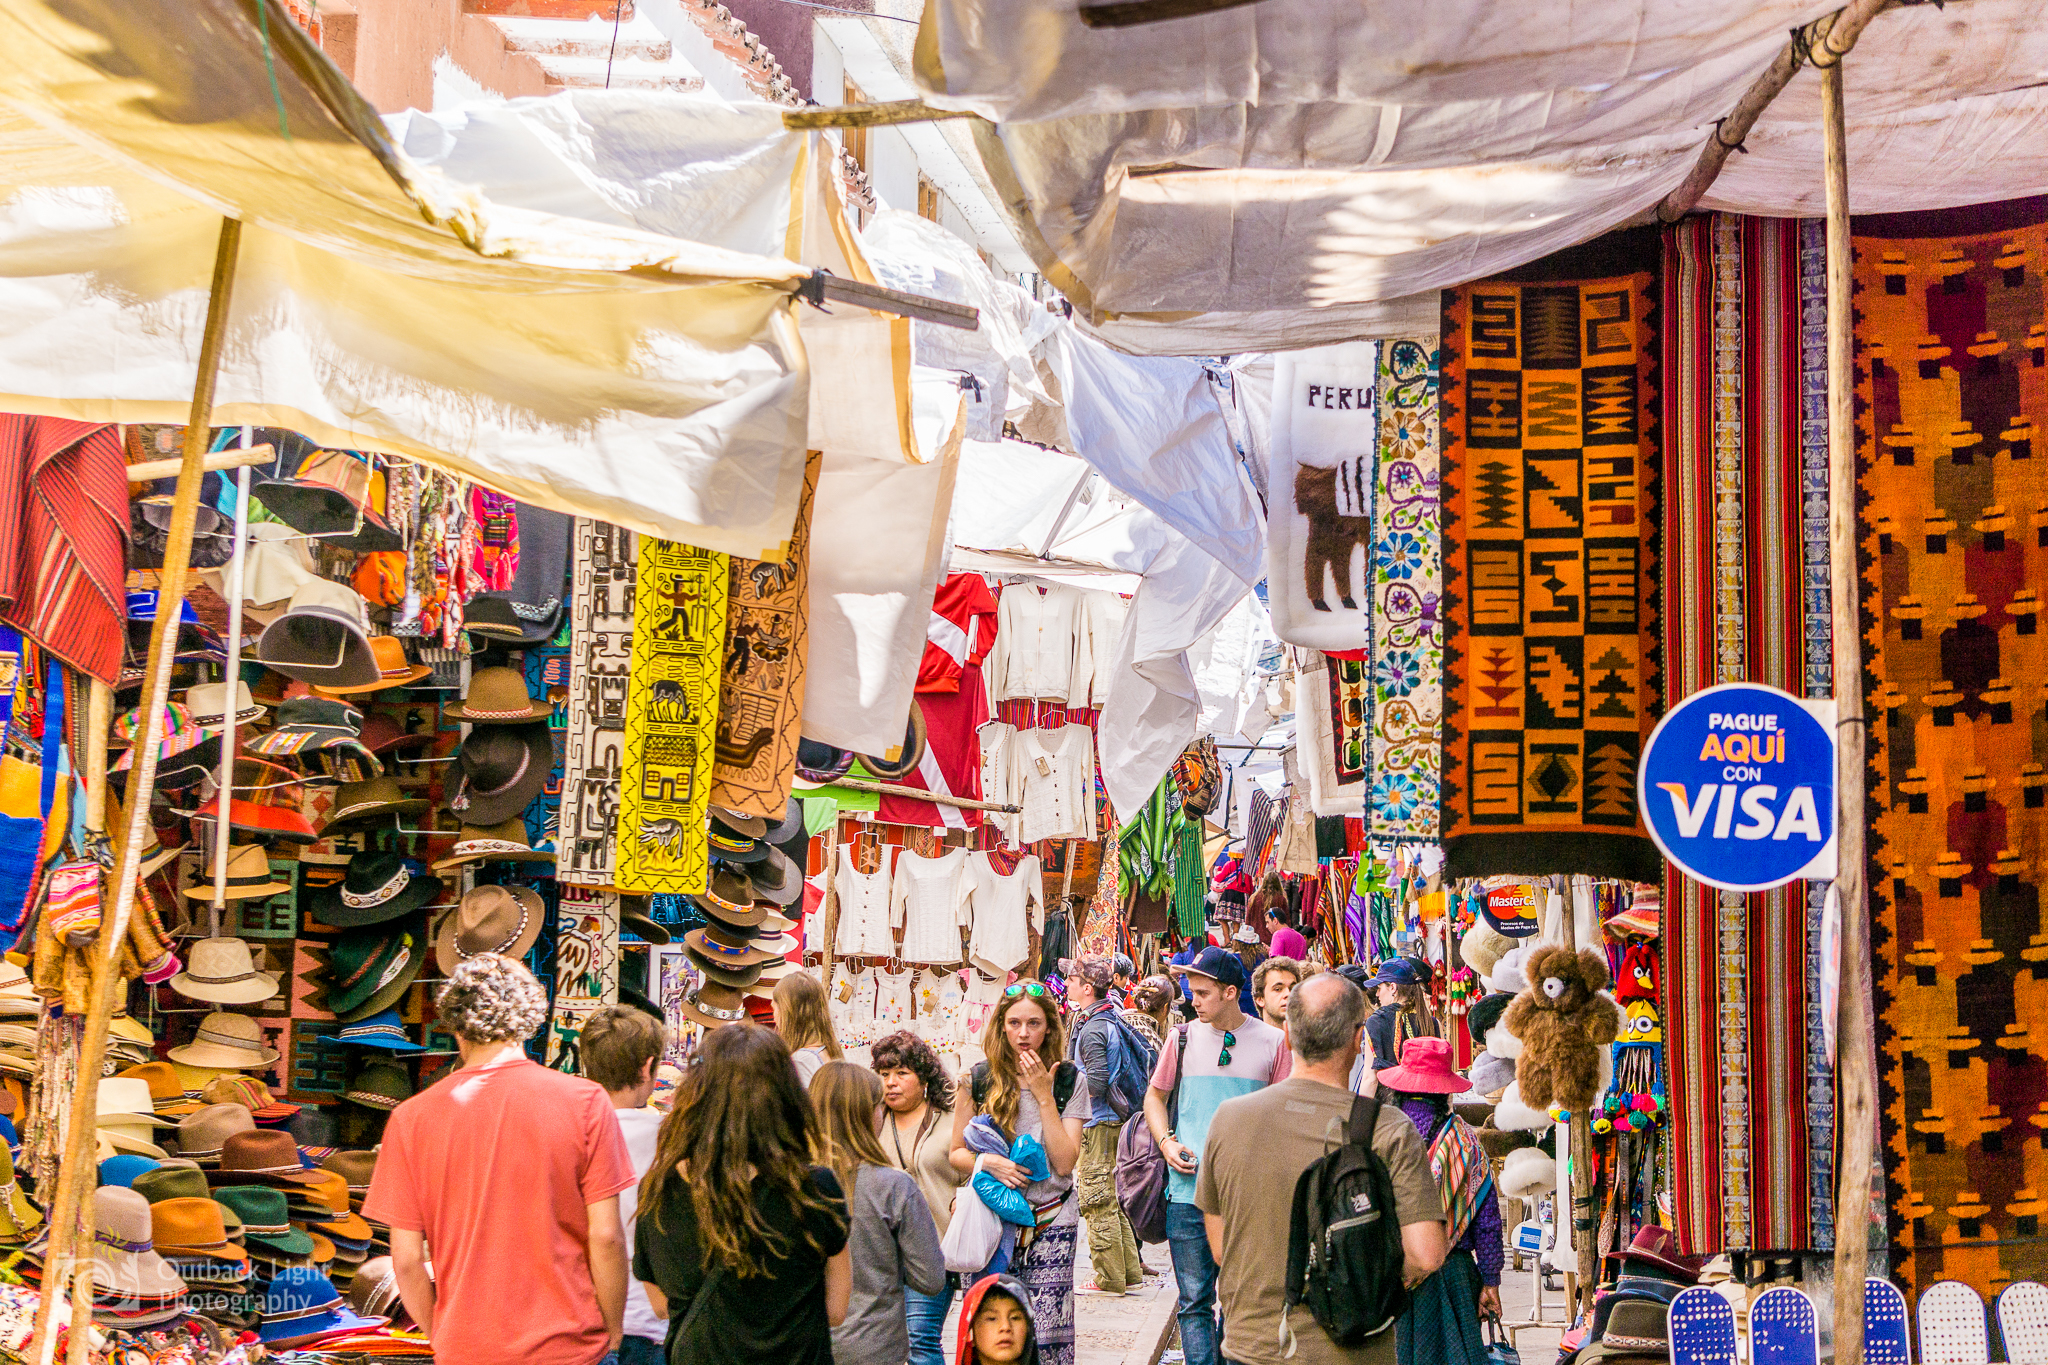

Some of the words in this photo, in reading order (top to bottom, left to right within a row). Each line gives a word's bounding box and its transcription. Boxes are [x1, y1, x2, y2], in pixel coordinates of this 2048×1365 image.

[1308, 384, 1373, 409] PERU
[1708, 713, 1778, 731] PAGUE
[1699, 728, 1785, 763] AQUÍ
[1722, 766, 1761, 782] CON
[1656, 782, 1822, 842] VISA
[1489, 896, 1535, 907] MasterCa
